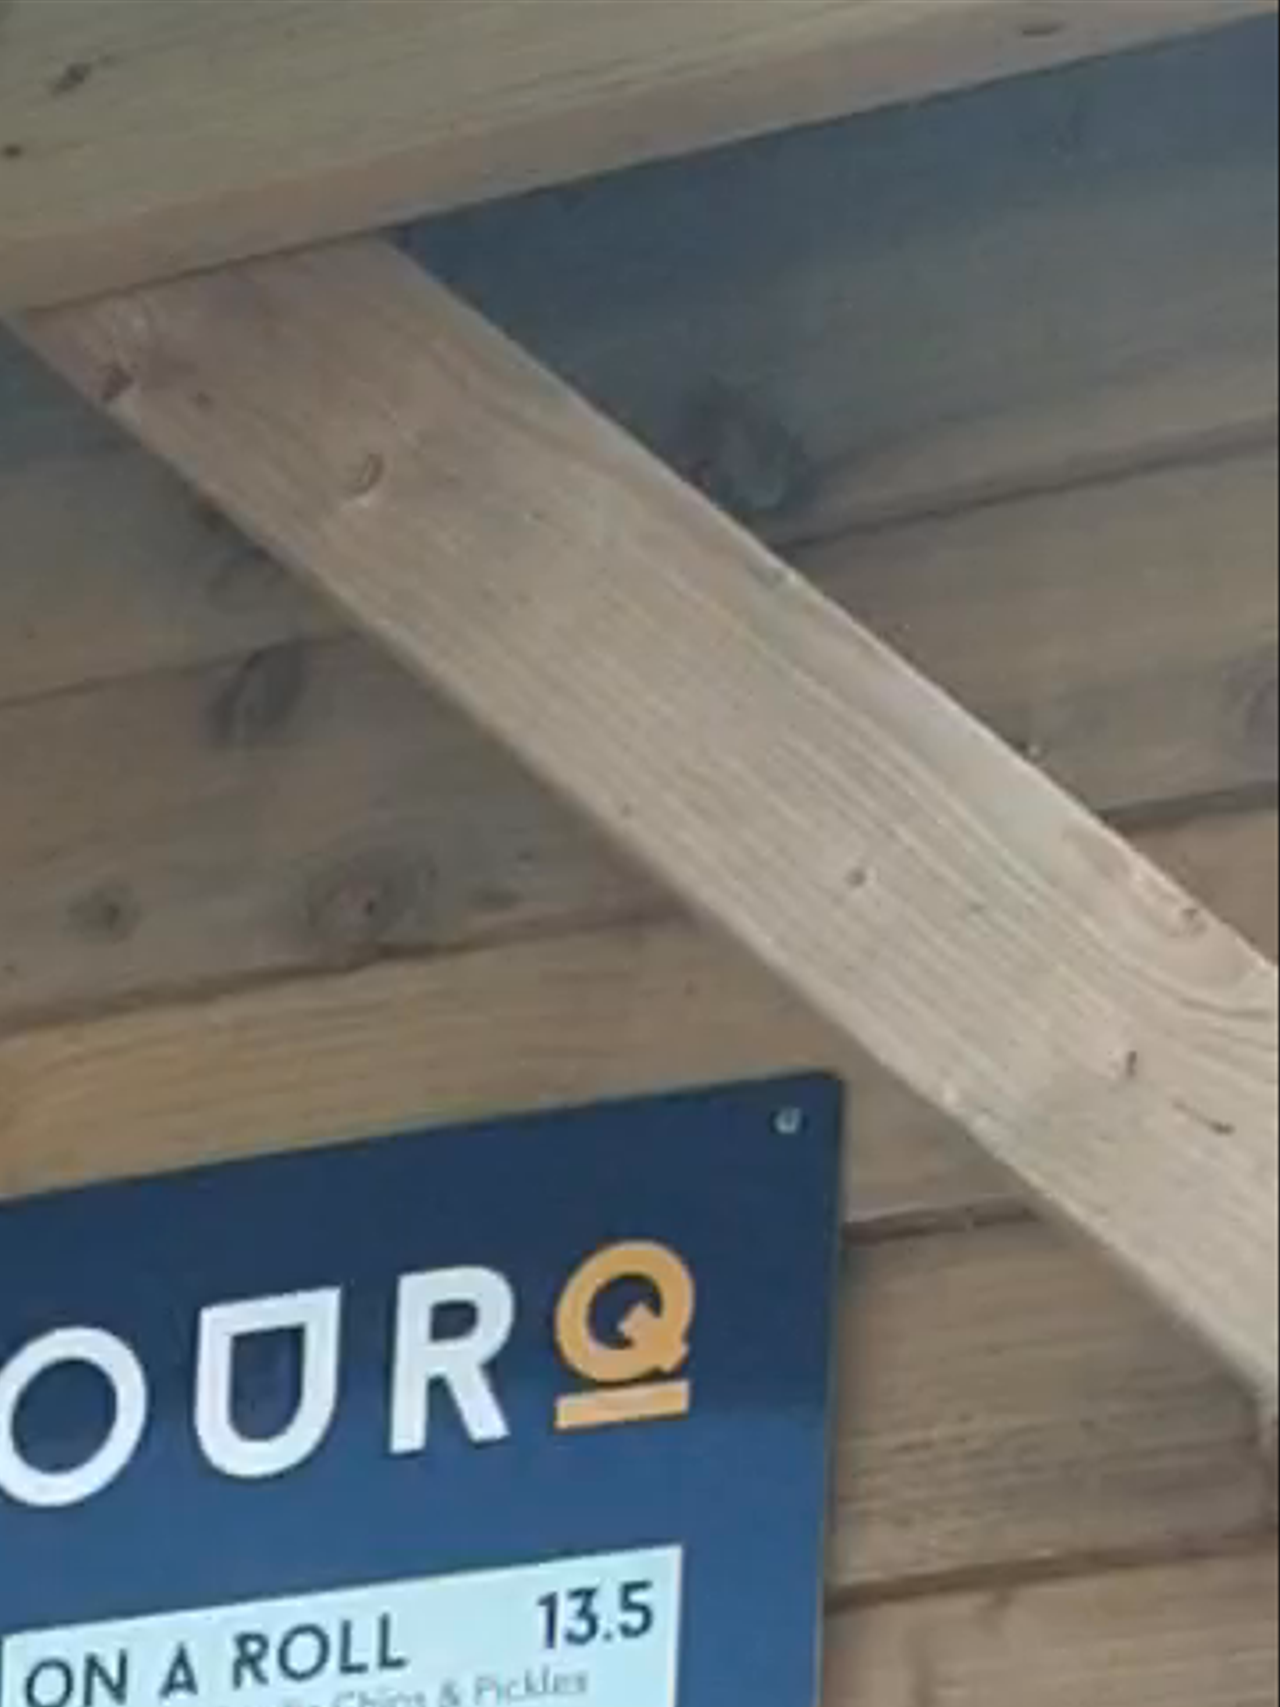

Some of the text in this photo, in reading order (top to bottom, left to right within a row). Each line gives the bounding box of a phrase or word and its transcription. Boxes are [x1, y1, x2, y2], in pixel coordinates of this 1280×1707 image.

[537, 1581, 653, 1651] 13.5
[158, 1641, 199, 1700] A
[232, 1613, 409, 1688] ROLL
[473, 1670, 589, 1706] Pickles
